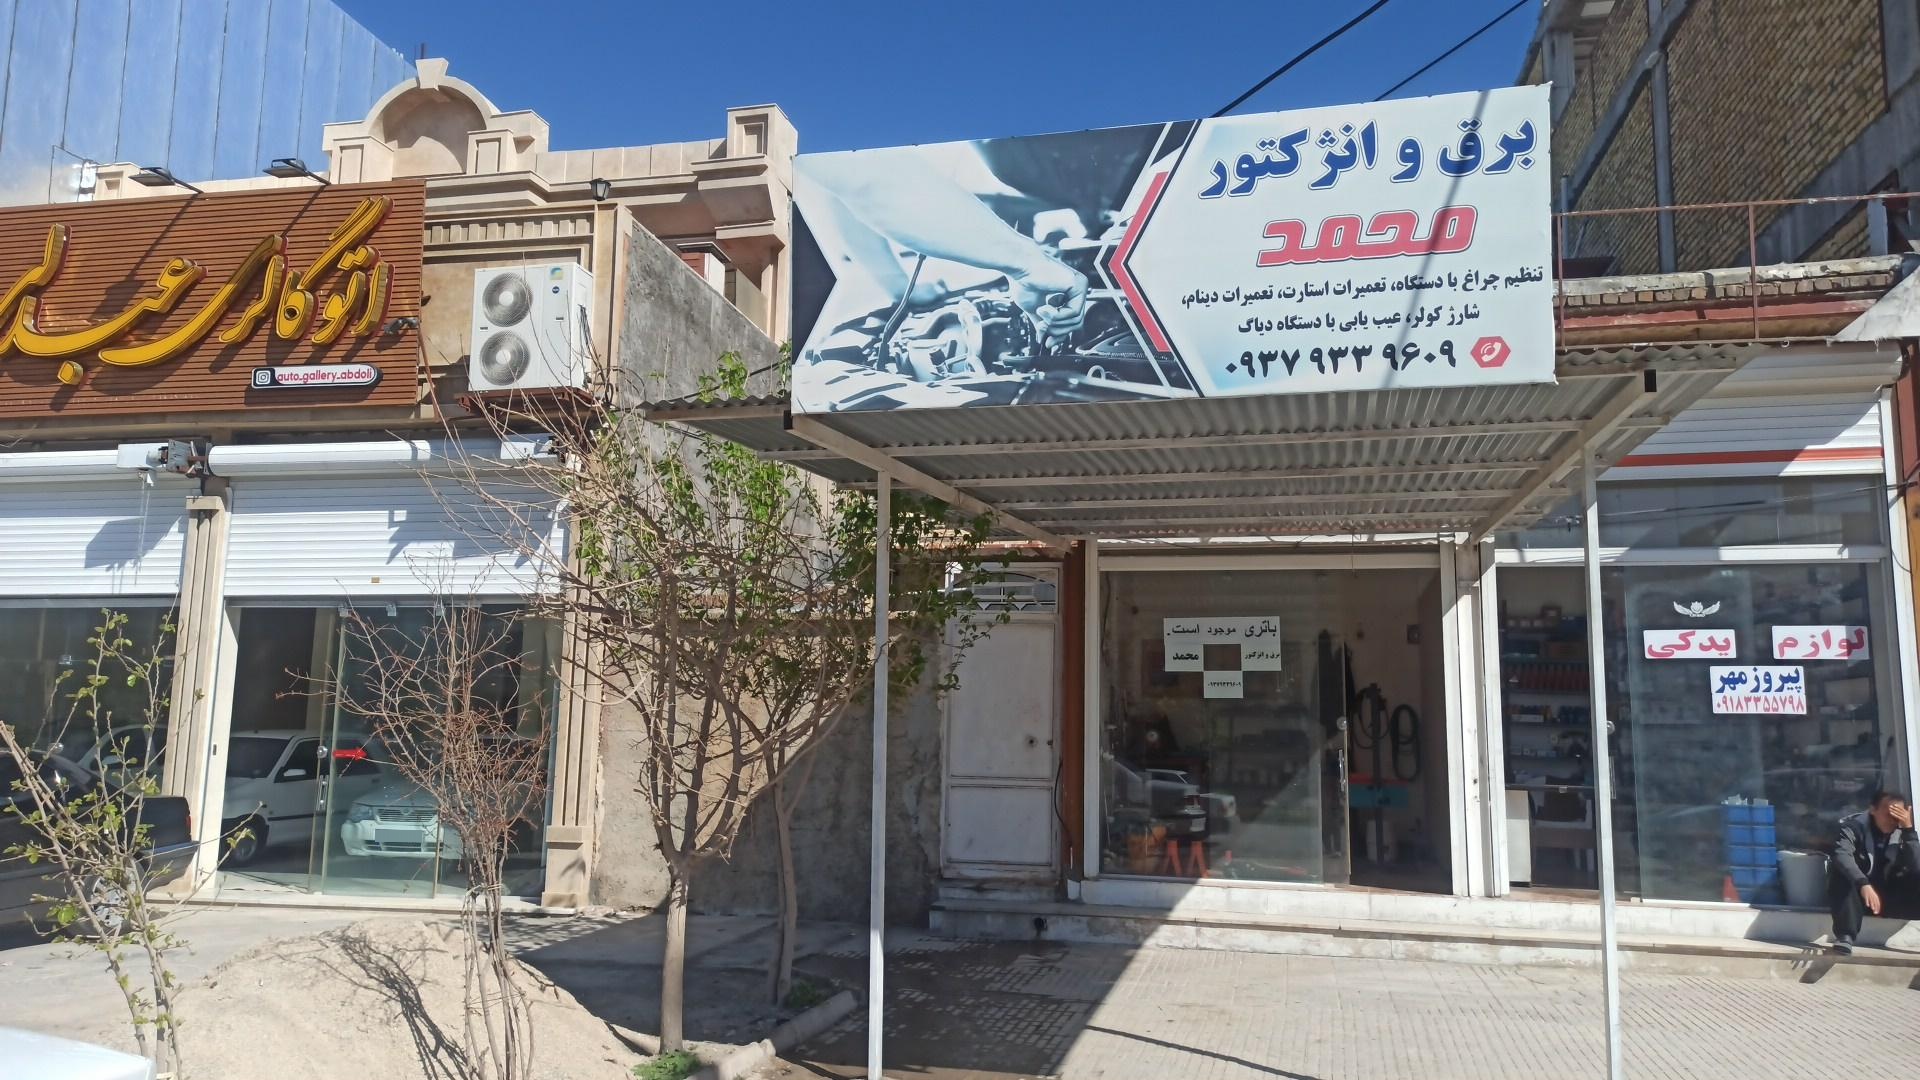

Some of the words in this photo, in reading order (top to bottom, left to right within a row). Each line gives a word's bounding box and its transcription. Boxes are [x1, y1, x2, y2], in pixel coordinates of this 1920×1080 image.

[1438, 118, 1537, 176] برق
[1391, 134, 1423, 182] و
[1256, 204, 1478, 267] محمد
[1390, 275, 1443, 291] دستگاه،
[1447, 272, 1458, 291] با
[1462, 269, 1500, 291] چراغ
[1505, 266, 1543, 288] تنظیم
[1222, 285, 1273, 306] تعمیرات
[1277, 281, 1329, 303] استارت،
[1333, 277, 1386, 299] تعمیرات
[1182, 289, 1218, 309] دینام،
[1277, 315, 1321, 330] دستگاه
[1325, 313, 1335, 331] با
[1339, 311, 1368, 332] یابی
[1372, 312, 1401, 329] عیب
[1406, 306, 1442, 328] کولر،
[1447, 304, 1480, 325] شارژ
[1208, 626, 1236, 635] موجود
[1245, 620, 1277, 637] باتری
[1647, 631, 1731, 658] یدکی
[1777, 627, 1865, 657] لوازم
[1172, 652, 1199, 660] محمد
[1717, 695, 1804, 713] ۰۹۱۸۳۳۵۵۷۹۸
